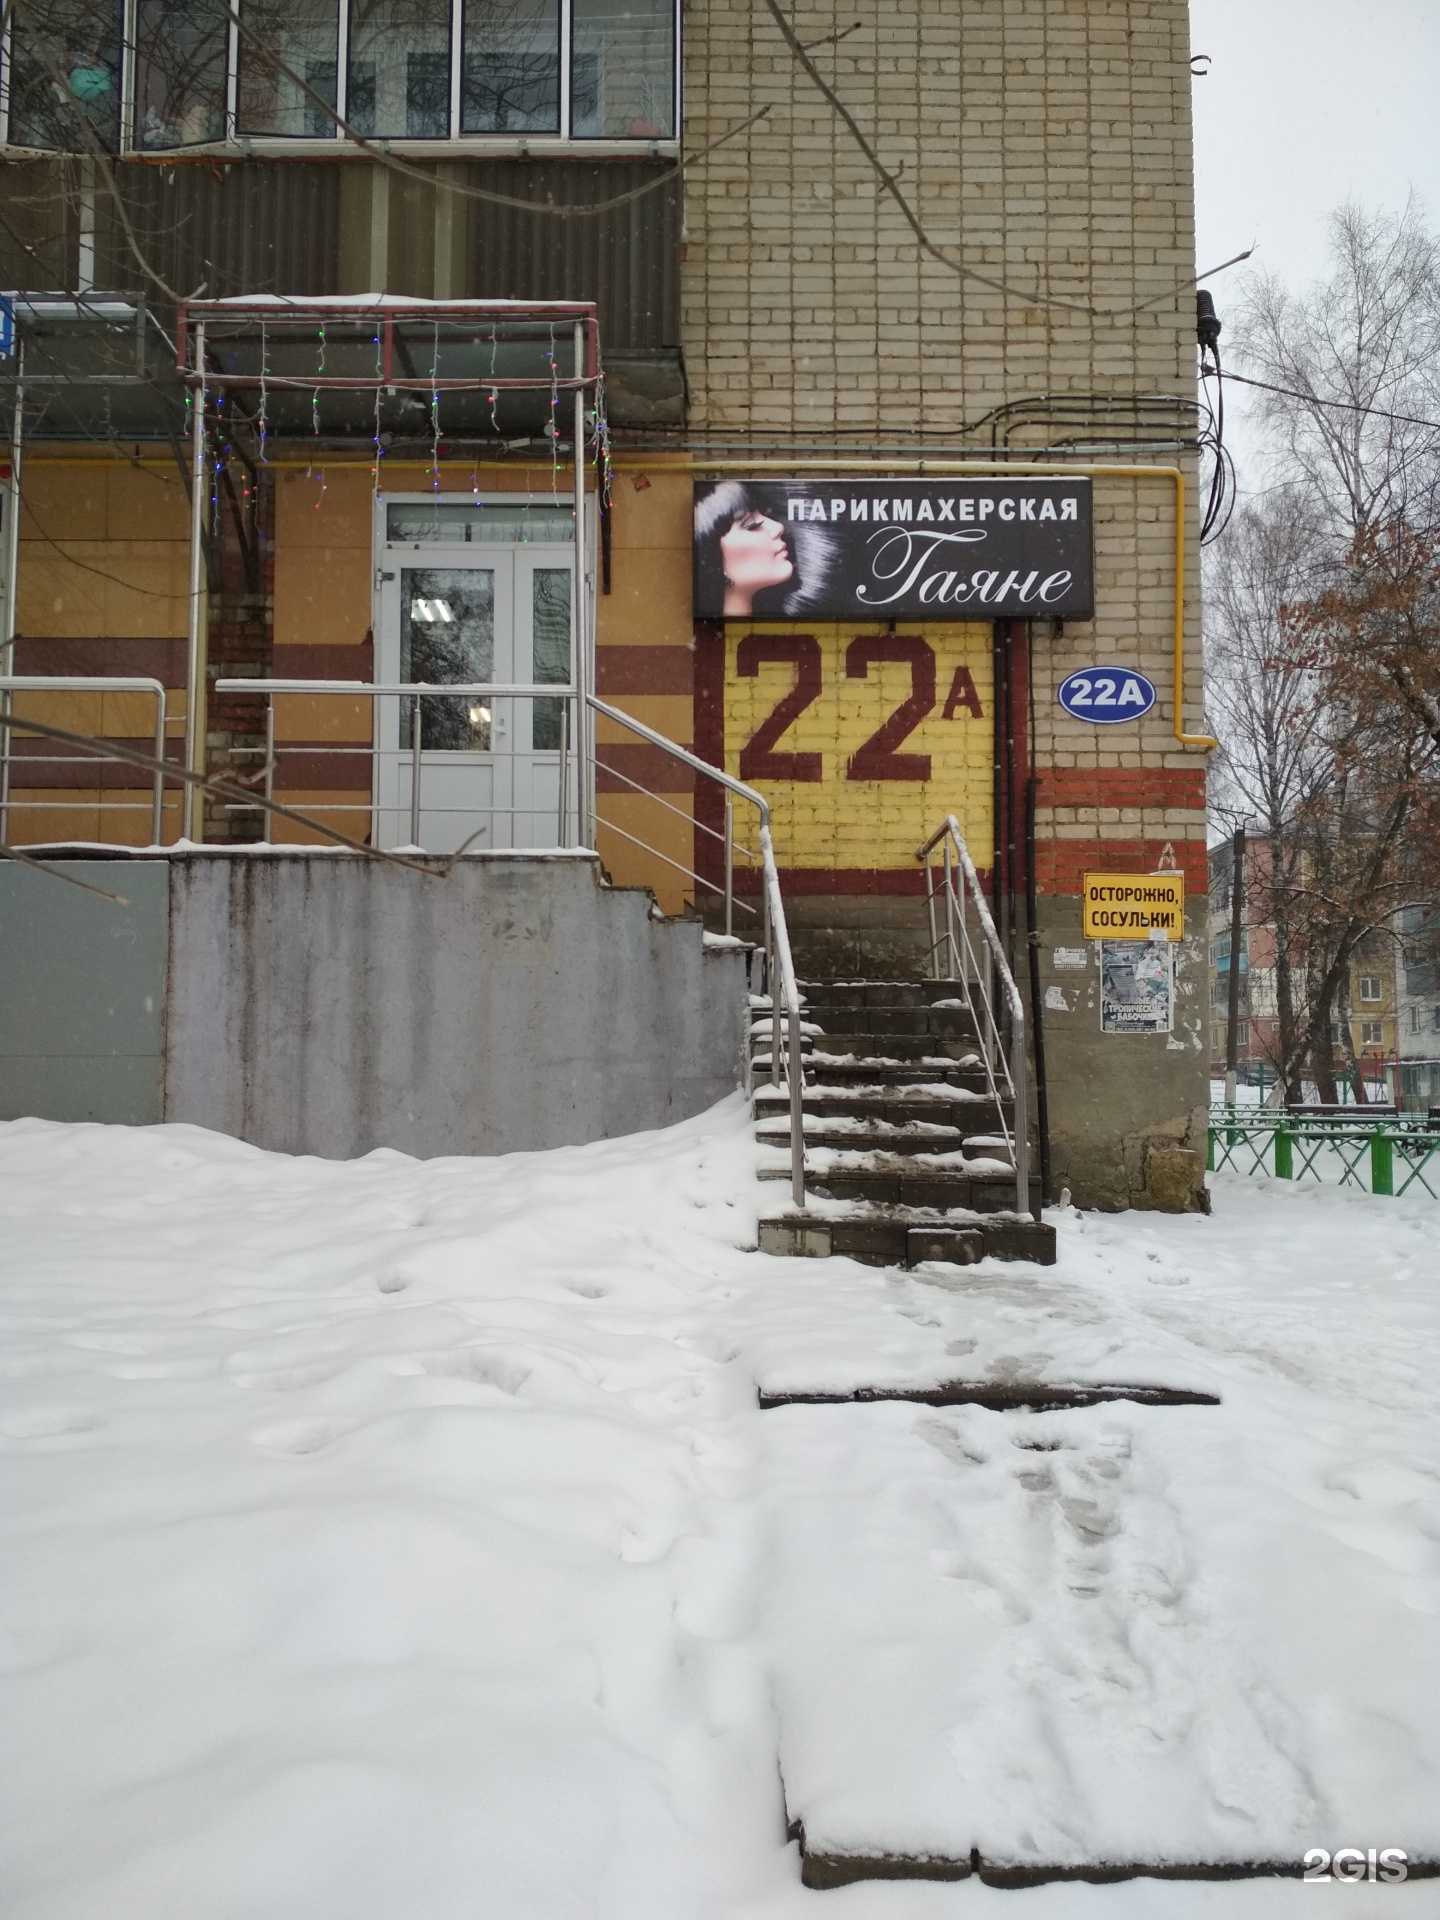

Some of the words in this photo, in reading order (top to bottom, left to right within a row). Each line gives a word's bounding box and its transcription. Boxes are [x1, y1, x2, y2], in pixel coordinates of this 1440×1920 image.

[787, 498, 1078, 521] ПАРИКМАХЕРСКАЯ
[856, 526, 1073, 605] Таяне
[1070, 678, 1146, 706] 22А
[1090, 887, 1179, 904] ОСТОРОЖНО,
[1091, 911, 1175, 928] СОСУЛЬКИ!
